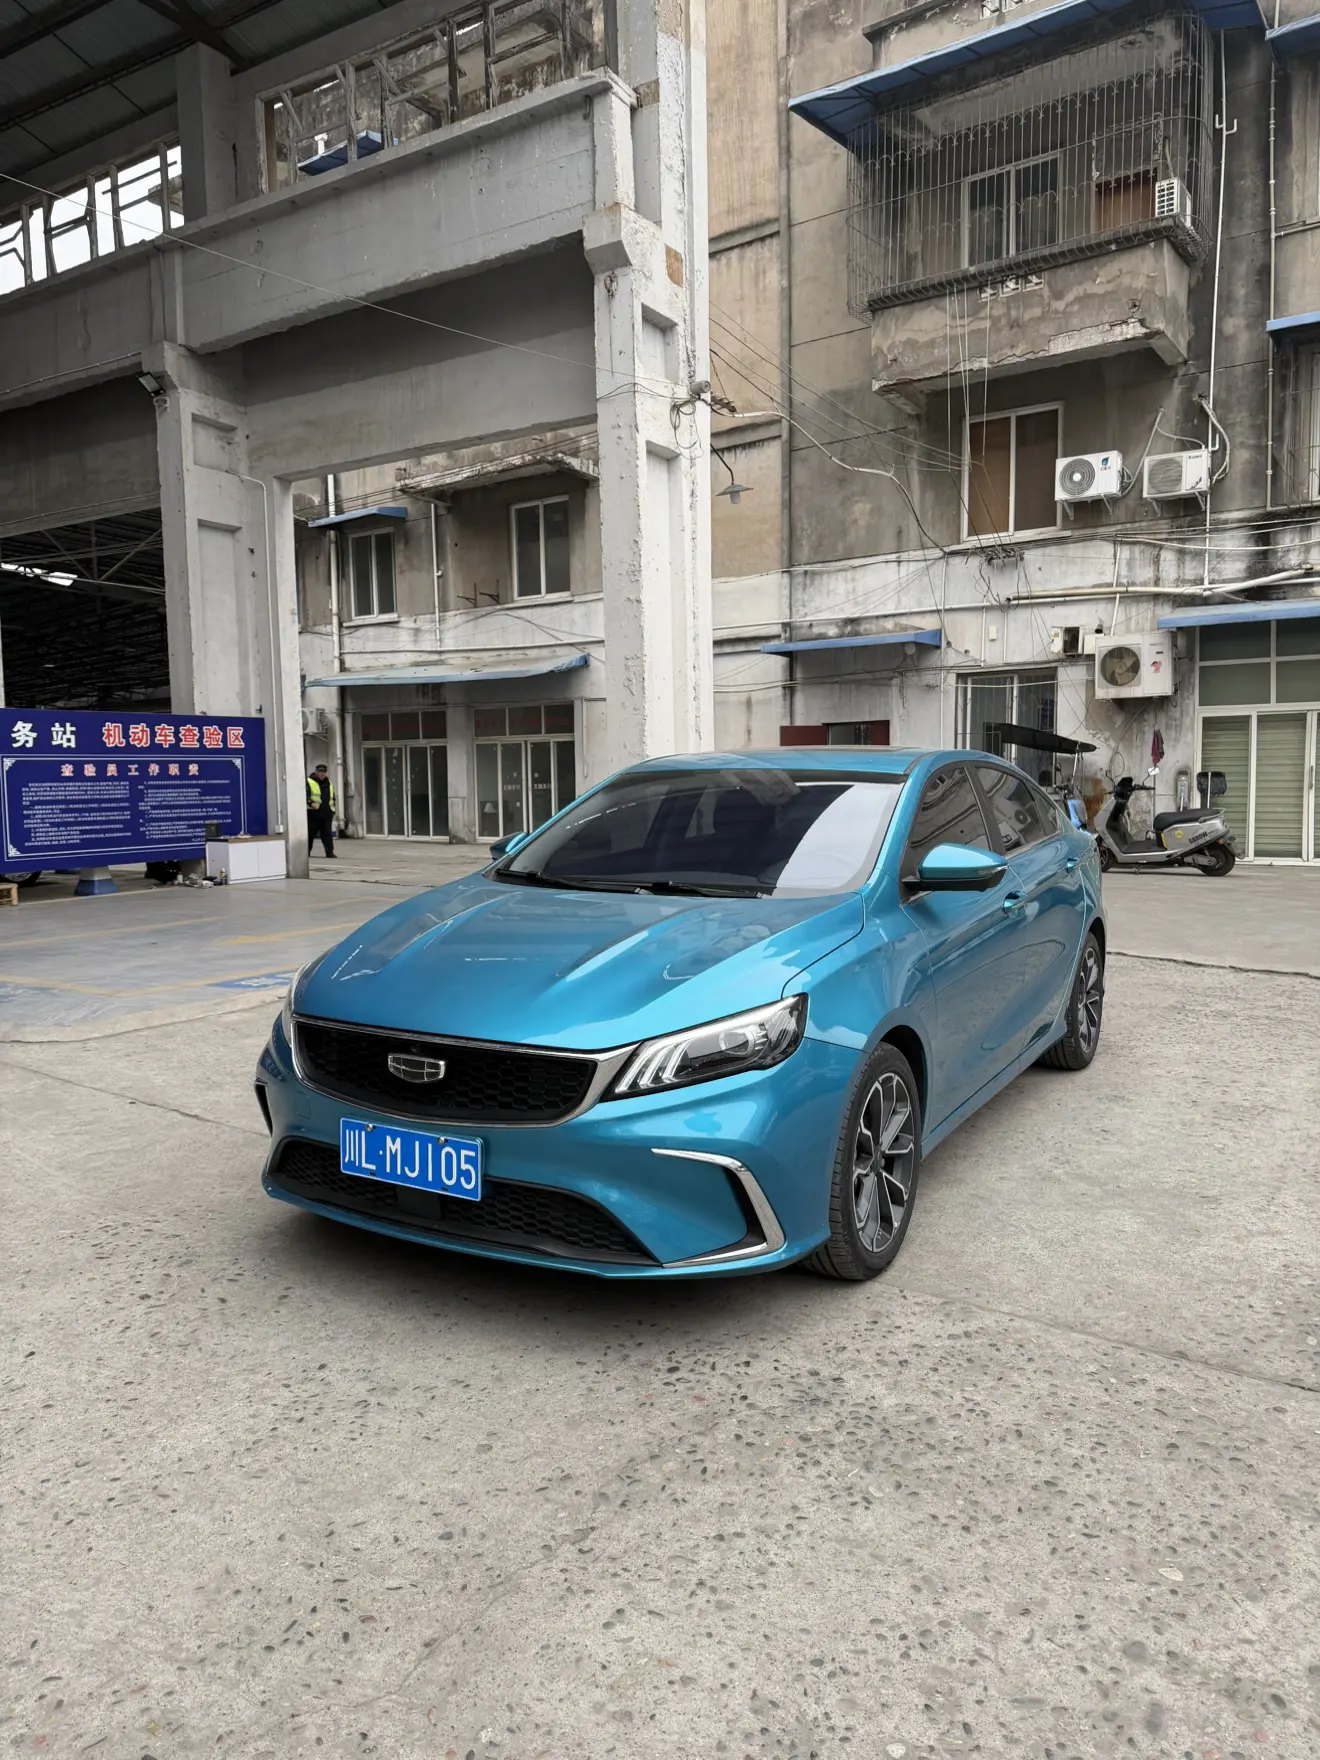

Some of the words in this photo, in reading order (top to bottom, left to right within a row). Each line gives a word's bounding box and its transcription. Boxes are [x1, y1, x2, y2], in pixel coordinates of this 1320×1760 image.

[102, 723, 245, 749] 机动车查验区
[61, 763, 199, 777] 查验员工作职责
